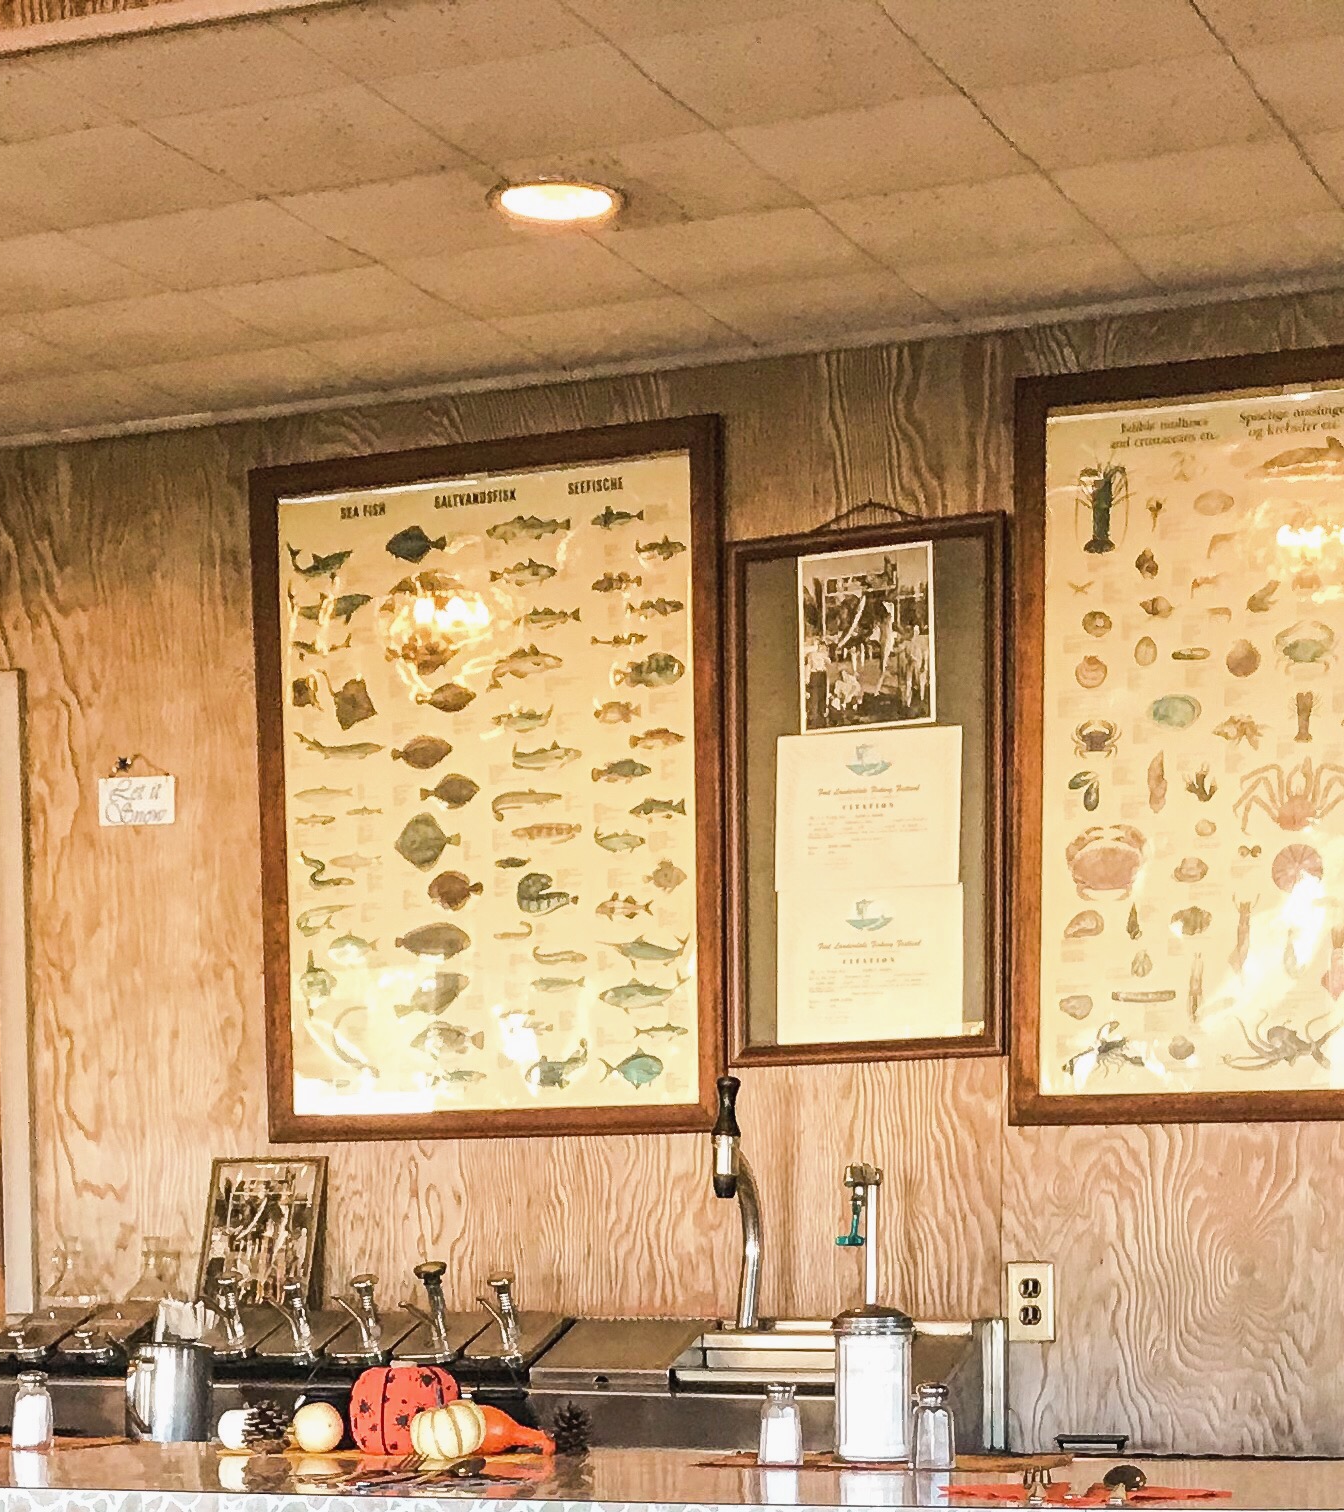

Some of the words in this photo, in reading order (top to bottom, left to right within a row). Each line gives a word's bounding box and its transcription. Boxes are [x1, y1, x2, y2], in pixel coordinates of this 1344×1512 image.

[1110, 436, 1131, 450] and
[567, 476, 624, 496] SEEFISCHE
[340, 505, 360, 520] SEA
[363, 502, 387, 517] FISH
